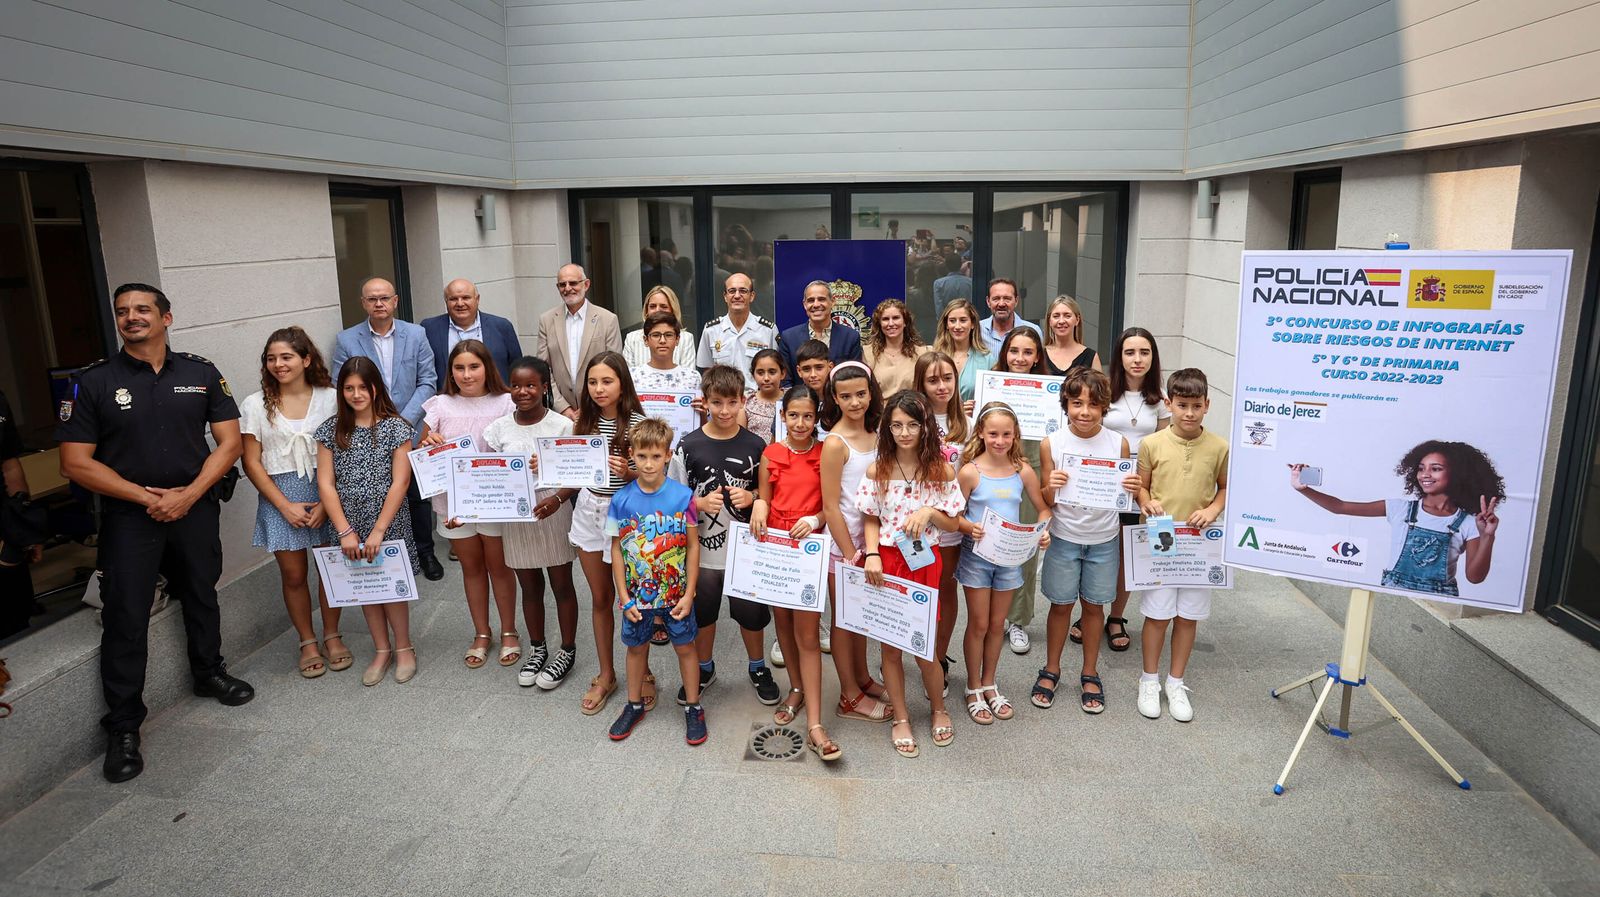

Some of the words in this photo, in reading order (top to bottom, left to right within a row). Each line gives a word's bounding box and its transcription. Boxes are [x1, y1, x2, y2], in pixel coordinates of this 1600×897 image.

[1254, 268, 1369, 286] POLICÍA
[1253, 287, 1399, 307] NACIONAL
[1285, 316, 1373, 331] CONCURSO
[1376, 319, 1399, 331] DE
[1402, 320, 1525, 335] INFOGRAFÍAS
[1271, 331, 1323, 344] SOBRE
[1325, 334, 1394, 347] RIESGOS
[1396, 337, 1421, 349] DE
[1423, 338, 1515, 352] INTERNET
[1330, 354, 1340, 364] Y
[1360, 356, 1380, 367] DE
[1382, 358, 1460, 371] PRIMARIA
[1321, 368, 1368, 380] CURSO
[1370, 371, 1444, 385] 2022-2023
[1259, 387, 1289, 395] trabajos
[1341, 393, 1384, 401] publicarán
[1244, 400, 1276, 414] Diario
[1277, 403, 1291, 416] de
[1292, 404, 1321, 419] Jerez
[1241, 513, 1276, 523] Colabora:
[1284, 543, 1307, 552] Andalucía
[1326, 557, 1363, 567] Carrefour
[751, 570, 770, 578] CENTRO
[771, 574, 801, 584] EDUCATIVO
[761, 578, 788, 588] FINALISTA
